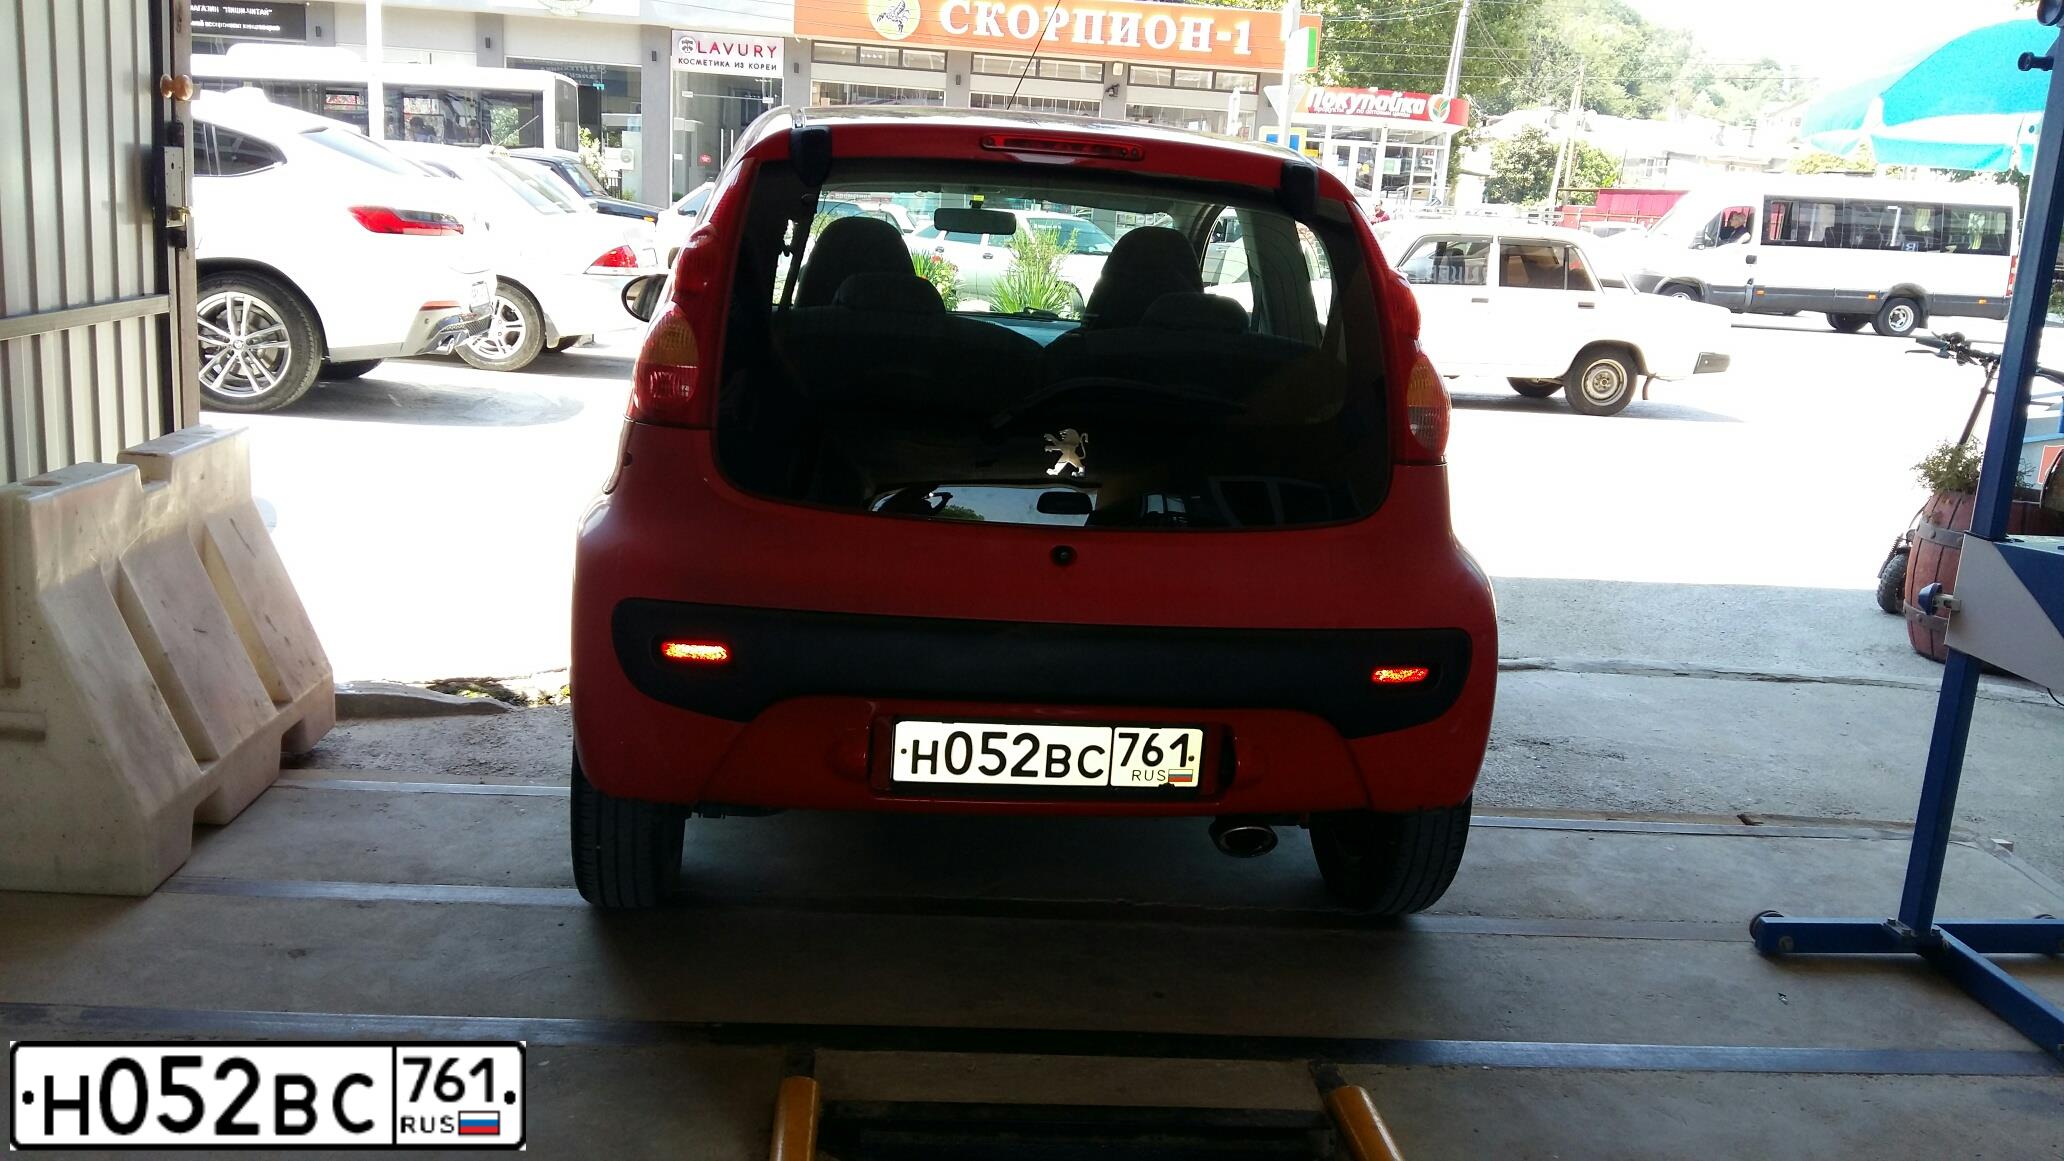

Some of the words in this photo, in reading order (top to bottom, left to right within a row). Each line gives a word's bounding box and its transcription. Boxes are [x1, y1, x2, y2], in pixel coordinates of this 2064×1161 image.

[939, 0, 1252, 55] СКОРПИОН-1
[697, 41, 777, 58] LAVURY
[678, 58, 730, 68] КОСМЕТИКА
[748, 63, 777, 71] КОРЕИ
[1306, 87, 1426, 115] Покупайка
[1118, 733, 1190, 767] 761
[1131, 769, 1167, 782] RUS
